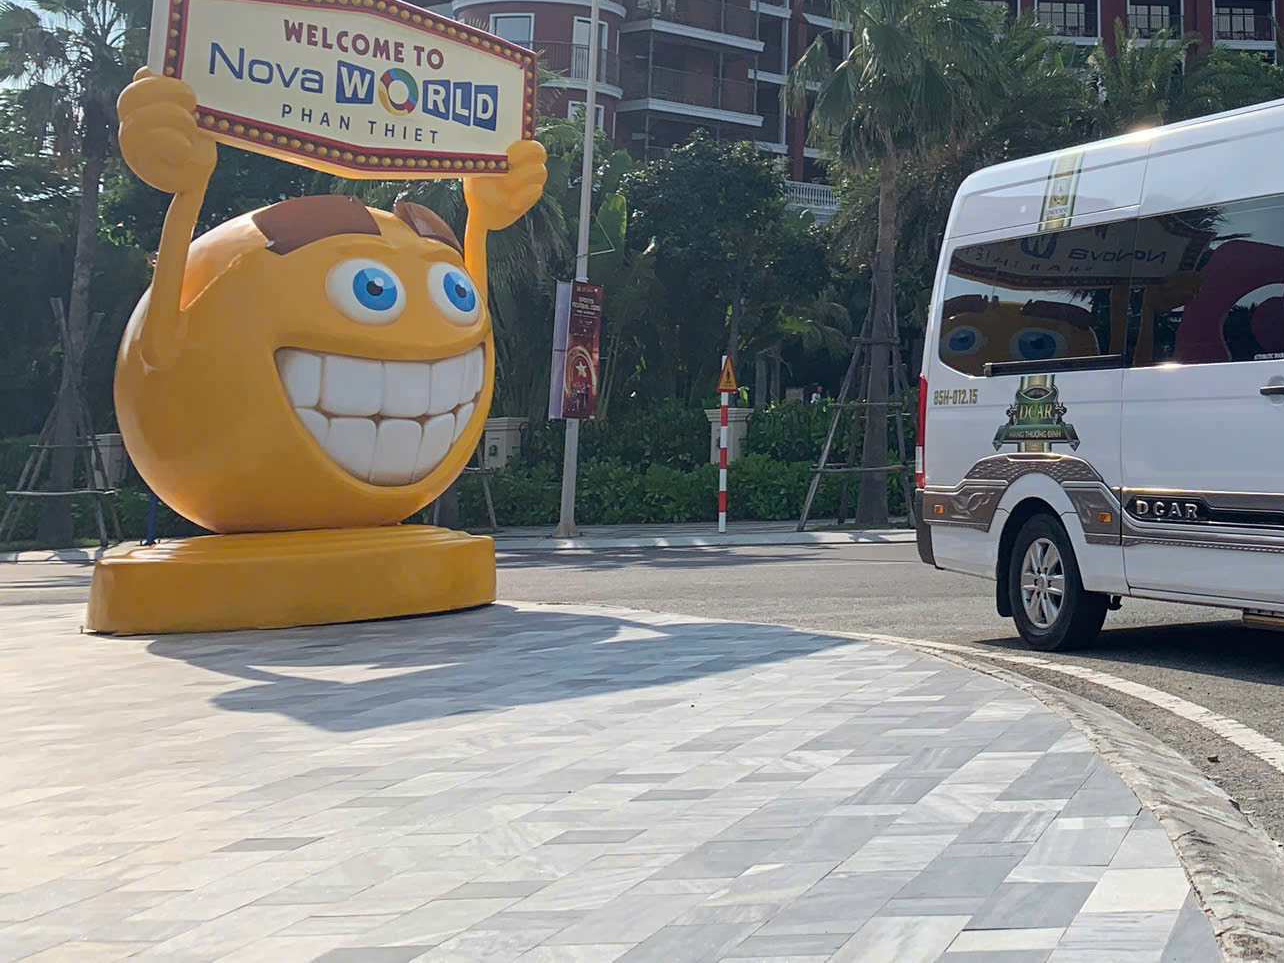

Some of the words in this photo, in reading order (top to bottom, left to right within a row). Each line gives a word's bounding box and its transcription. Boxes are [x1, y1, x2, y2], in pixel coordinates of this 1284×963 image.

[284, 18, 405, 63] WELCOME
[413, 45, 445, 70] TO
[281, 103, 351, 131] PHAN
[368, 120, 439, 144] THIET
[933, 389, 979, 406] 85H-012.15
[1018, 403, 1053, 420] DCAR
[1135, 499, 1198, 519] DCAR
